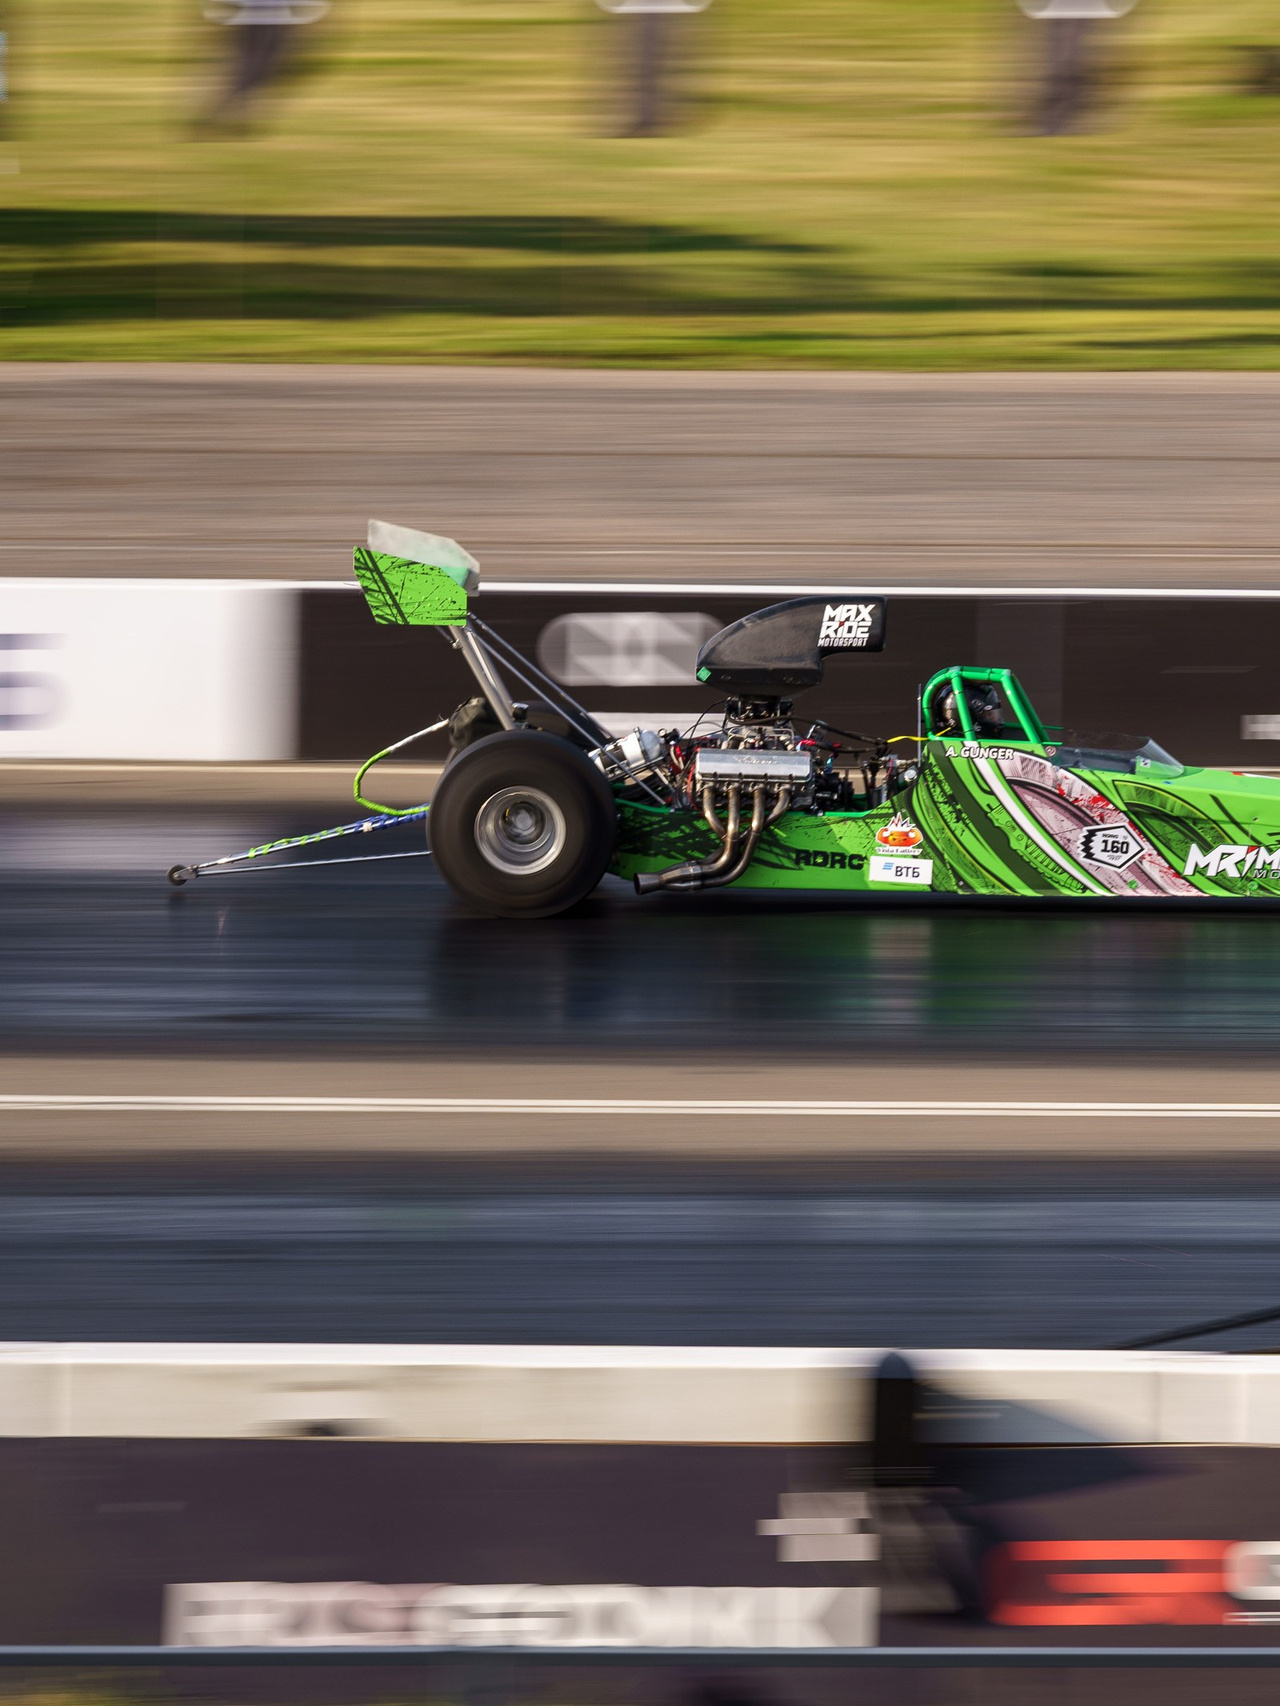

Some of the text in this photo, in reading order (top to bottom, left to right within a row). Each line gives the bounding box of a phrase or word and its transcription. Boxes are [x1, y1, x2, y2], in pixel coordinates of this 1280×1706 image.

[823, 604, 876, 622] MAX
[817, 637, 868, 647] MOTORSPORT
[945, 745, 1014, 760] A. GUNGER
[1101, 839, 1129, 854] 160
